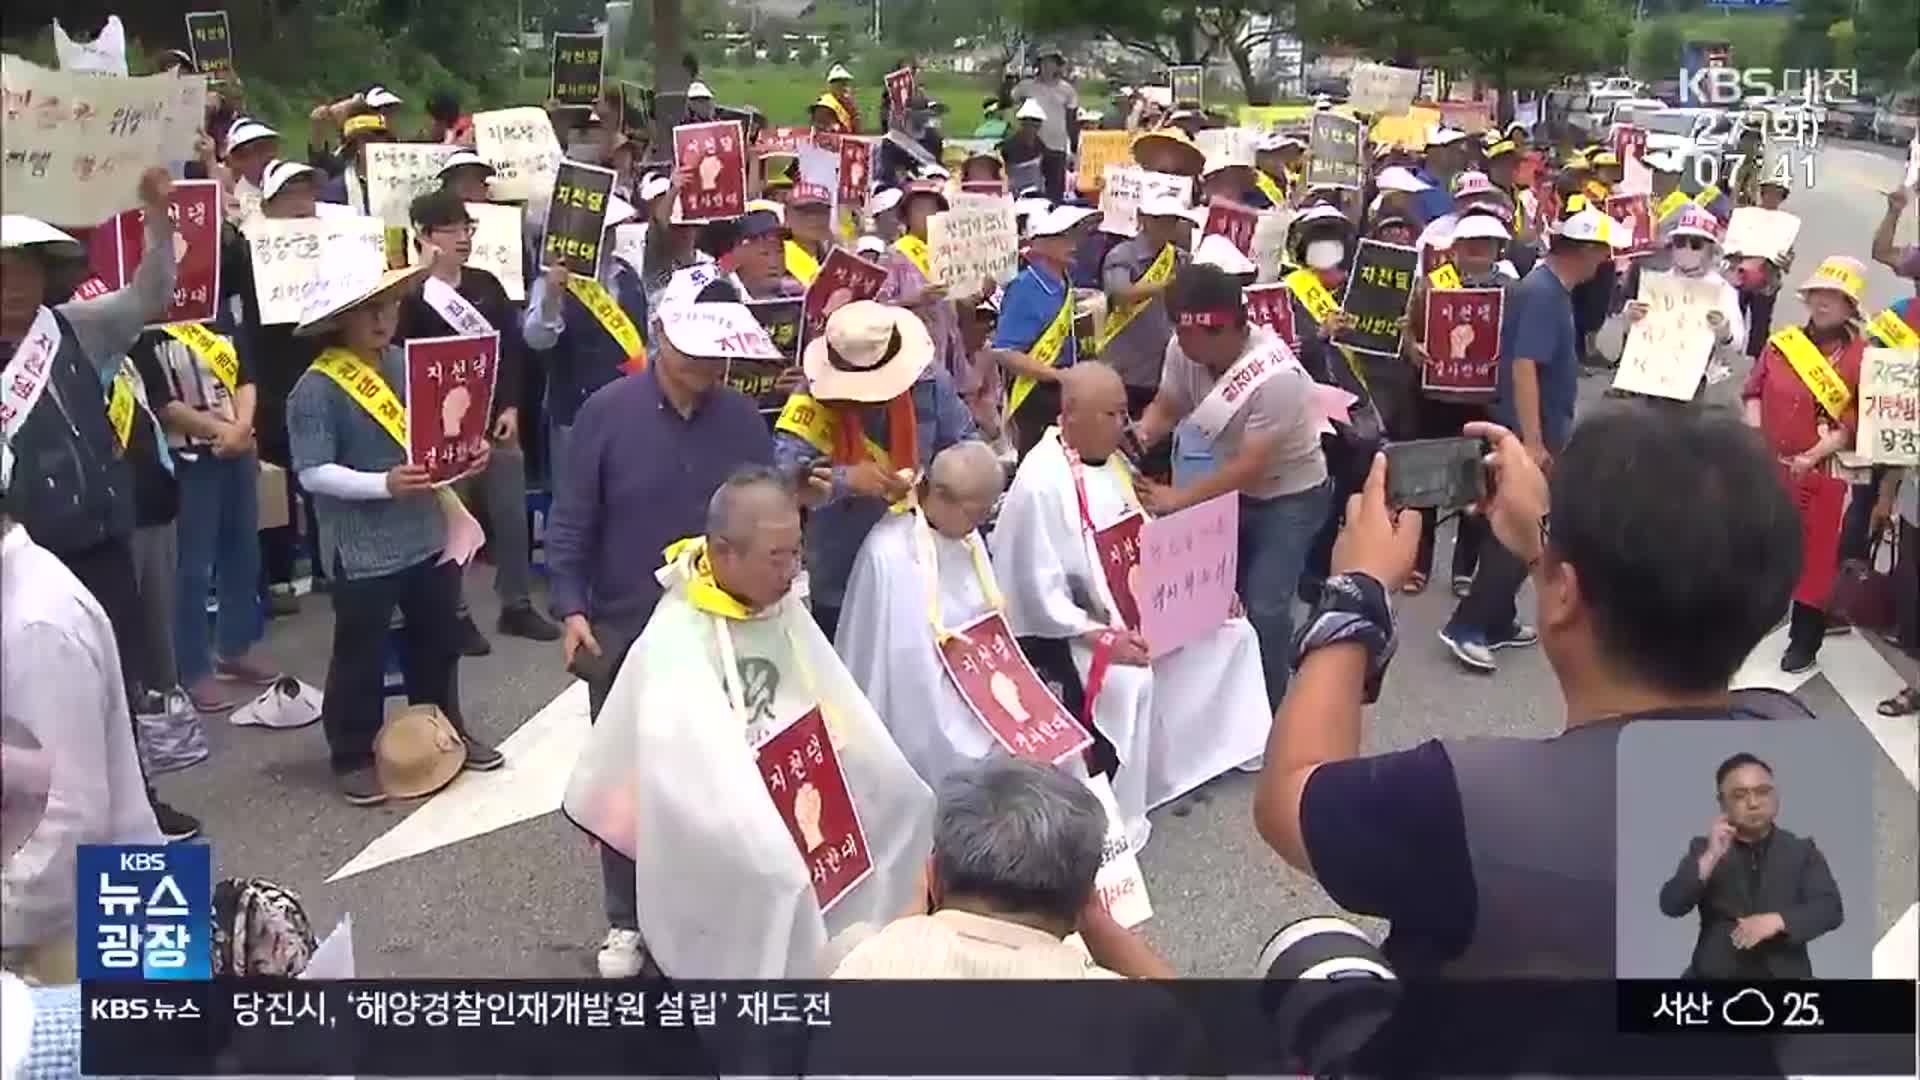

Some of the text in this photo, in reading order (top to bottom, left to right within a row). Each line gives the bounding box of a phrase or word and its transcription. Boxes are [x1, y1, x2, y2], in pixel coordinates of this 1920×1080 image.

[561, 49, 599, 64] 지천댐
[557, 185, 605, 212] 지천댐
[1361, 265, 1410, 291] 지천댐
[426, 352, 488, 385] 지천댐
[961, 632, 1011, 675] 지천댐
[769, 732, 825, 793] 지천댐
